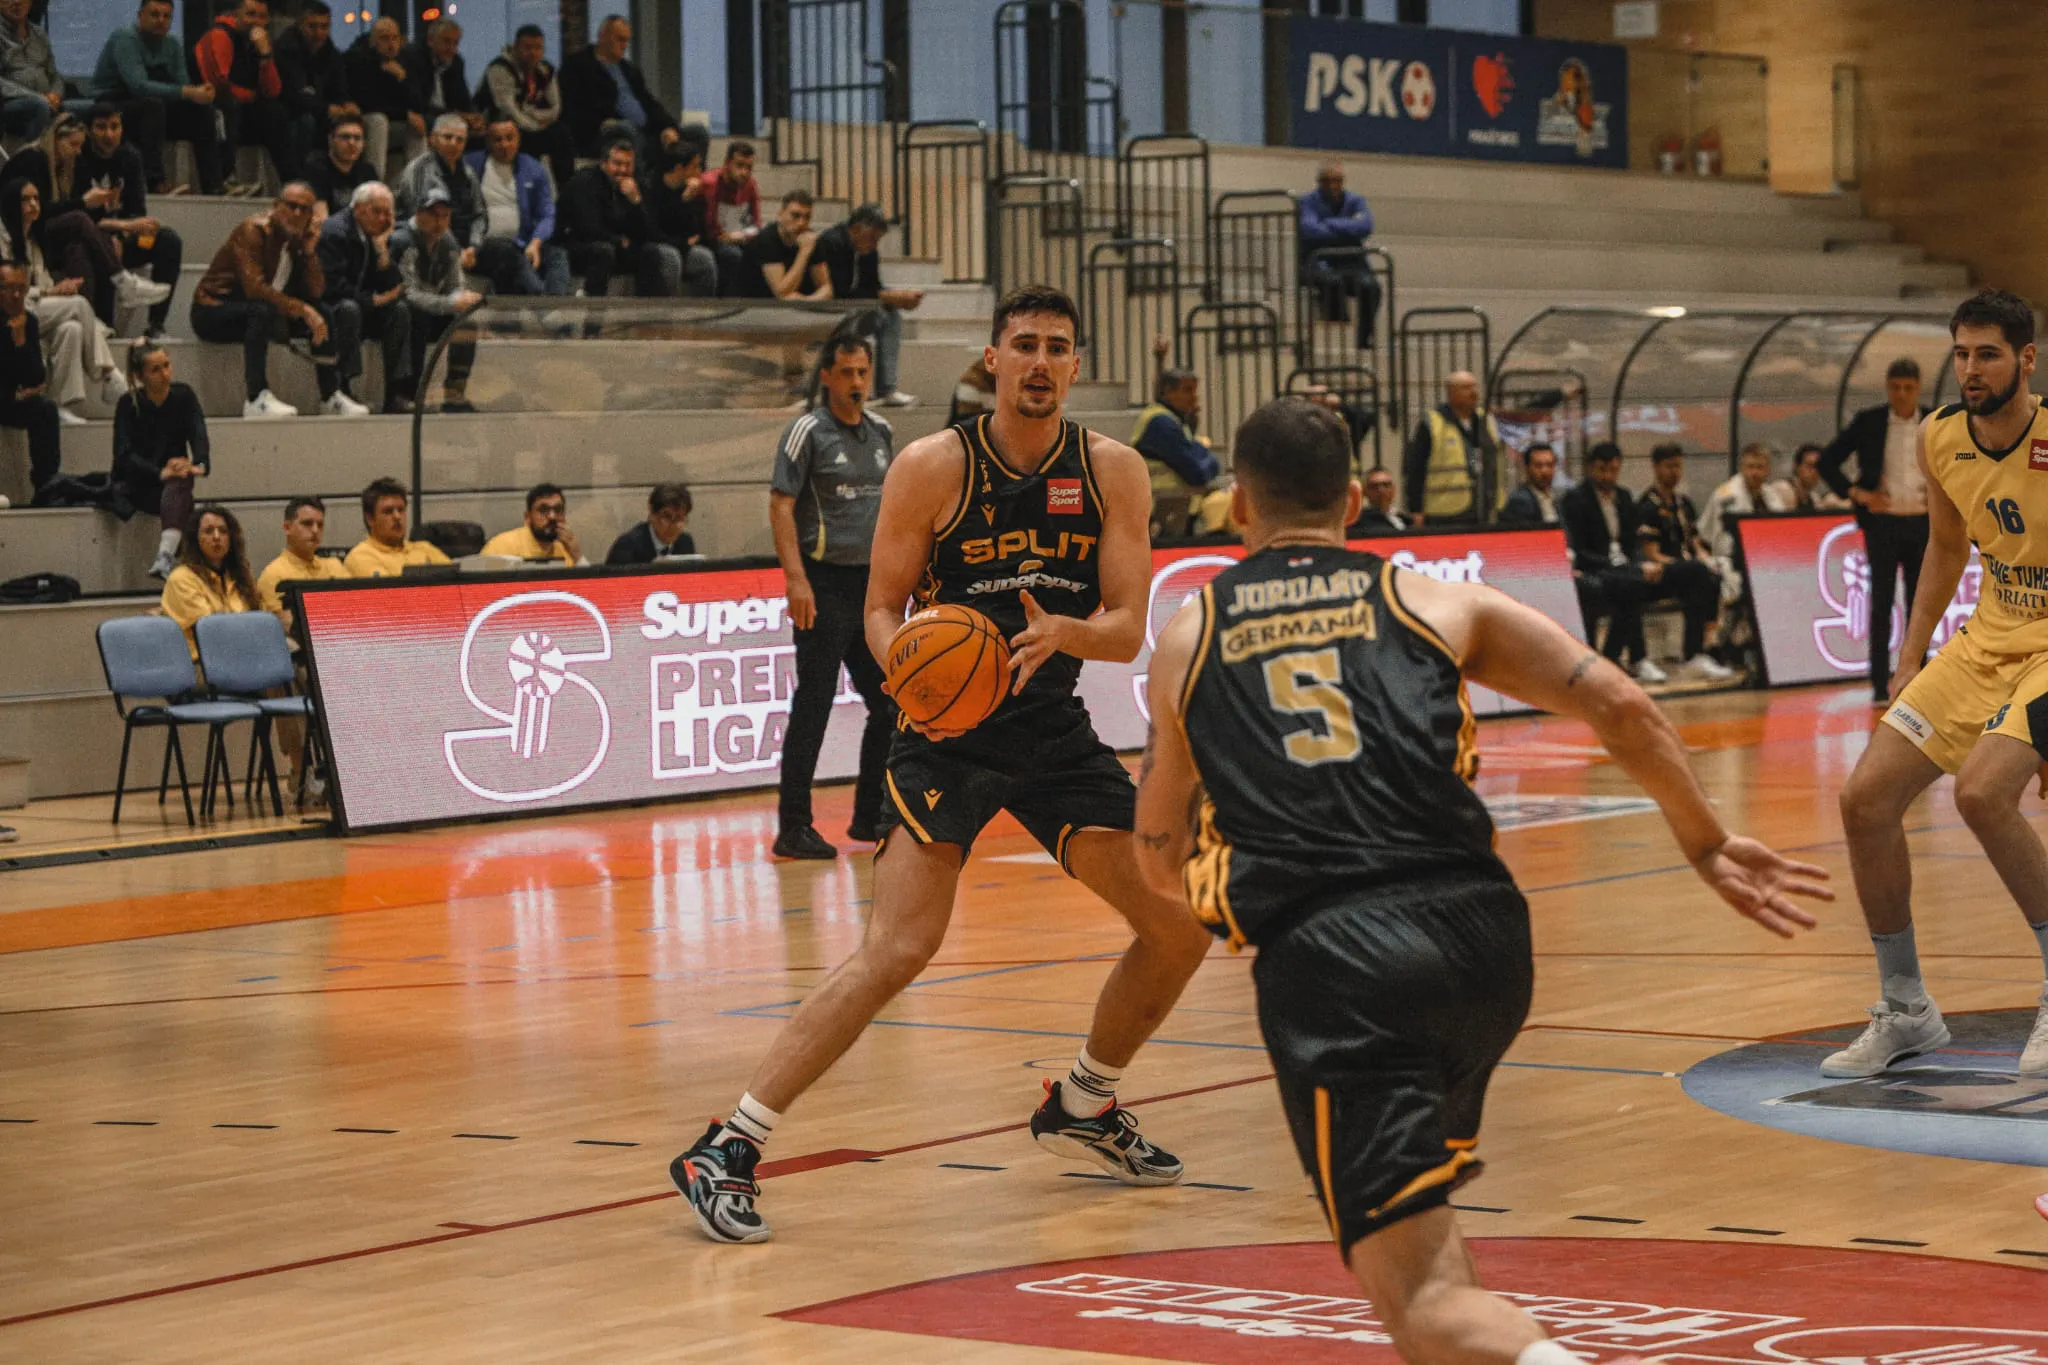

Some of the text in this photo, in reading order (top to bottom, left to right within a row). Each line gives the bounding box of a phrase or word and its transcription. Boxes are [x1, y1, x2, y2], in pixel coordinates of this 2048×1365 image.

[1304, 53, 1400, 118] PSK
[1048, 486, 1081, 497] Super
[1049, 496, 1081, 507] Sport
[1985, 498, 2025, 534] 16
[961, 528, 1097, 564] SPLIT
[640, 591, 794, 645] Super
[1227, 607, 1369, 654] GERMANIA
[1262, 646, 1363, 767] 5
[657, 710, 791, 772] LIGA
